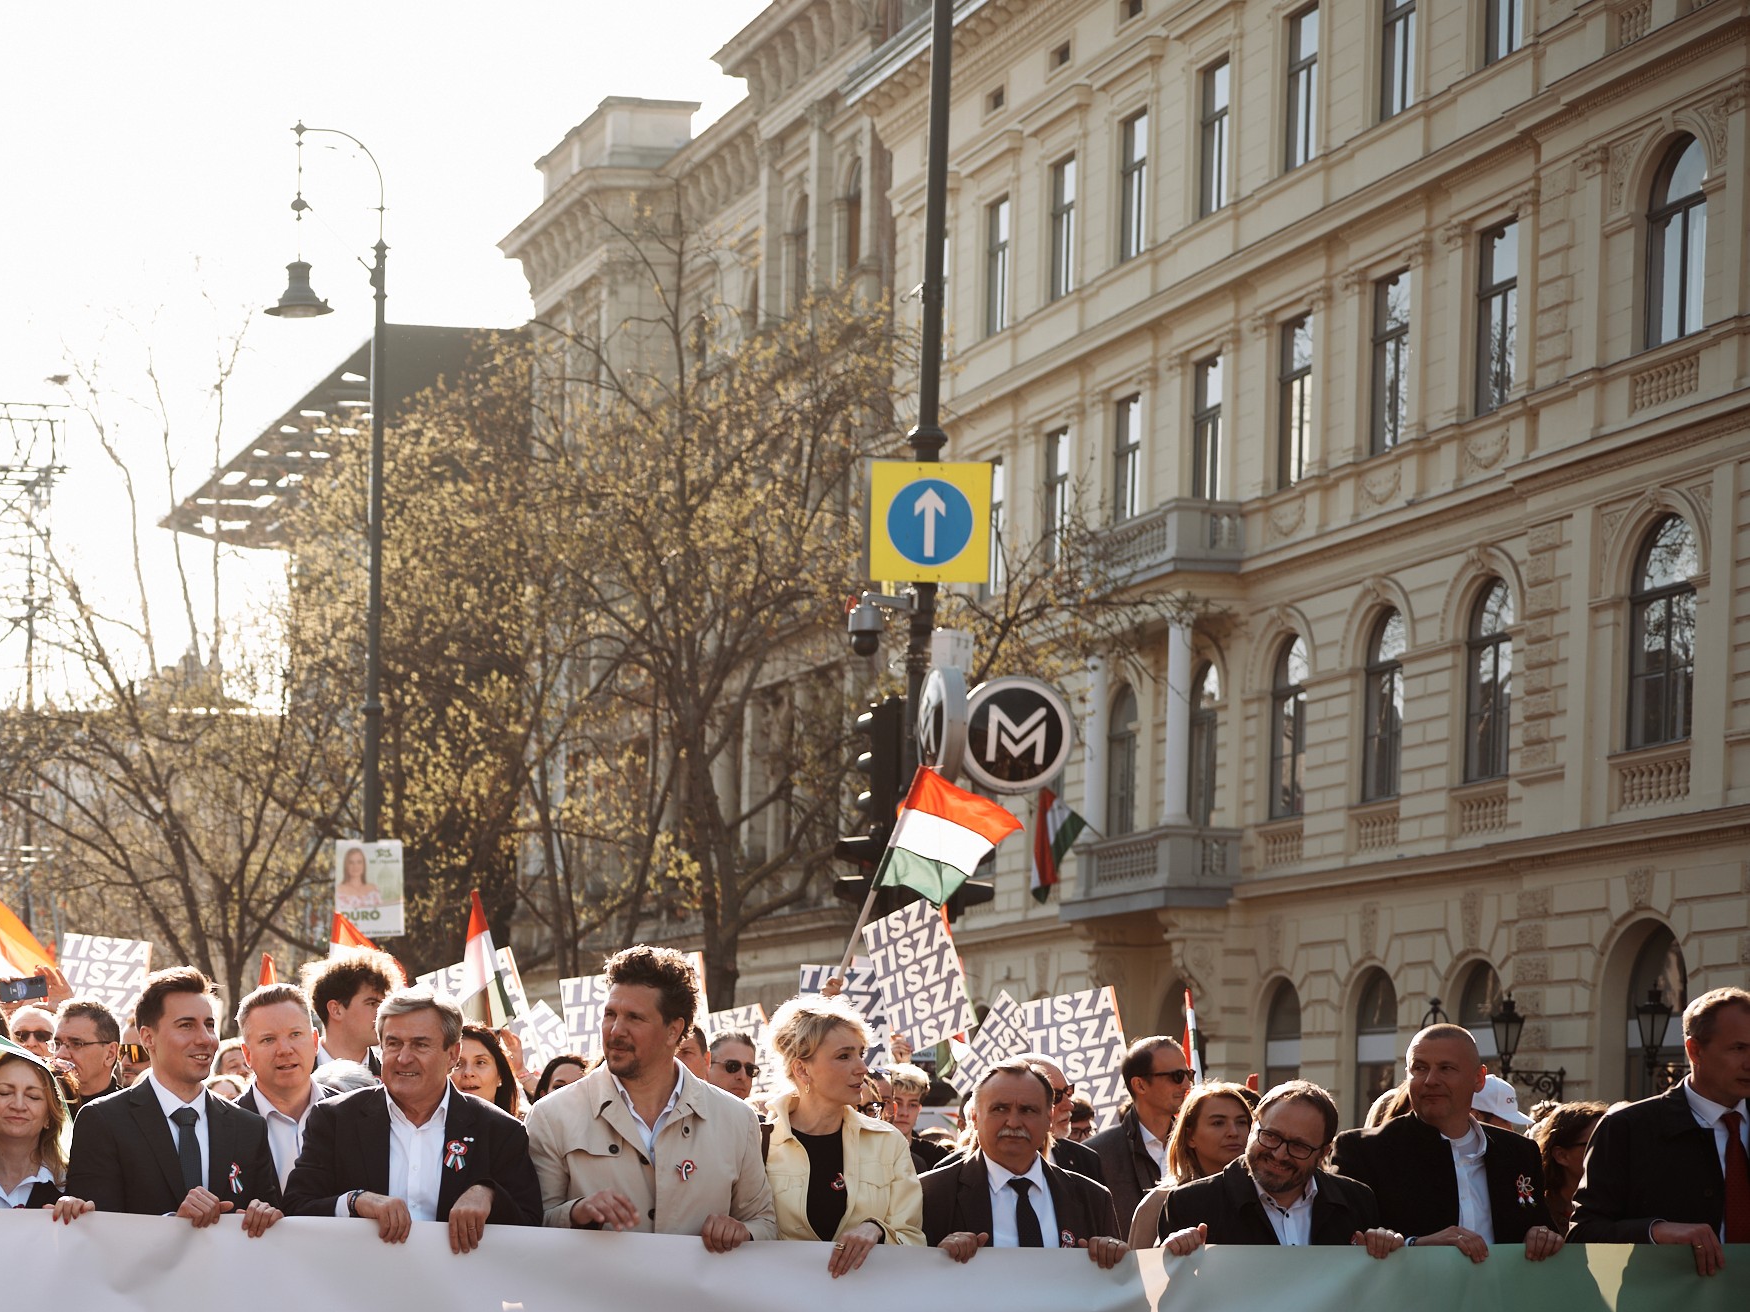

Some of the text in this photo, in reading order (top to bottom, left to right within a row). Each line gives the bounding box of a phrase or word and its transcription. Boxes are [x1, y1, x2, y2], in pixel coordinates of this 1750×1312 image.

[986, 704, 1047, 765] M
[862, 899, 941, 950] TISZA
[62, 932, 149, 964] TISZA
[869, 920, 952, 978] TISZA
[60, 958, 146, 989] TISZA
[561, 974, 608, 1004] TIS
[878, 948, 960, 1004] TISZA
[72, 986, 141, 1014] SZA
[887, 975, 969, 1031] TISZA
[993, 989, 1029, 1040] TIS
[1021, 985, 1115, 1028] TISZA
[530, 999, 567, 1048] TIS
[982, 1008, 1027, 1057] TISZ
[1028, 1015, 1122, 1055] TISZA
[1054, 1044, 1127, 1081] SZA
[1074, 1075, 1131, 1106] SZA
